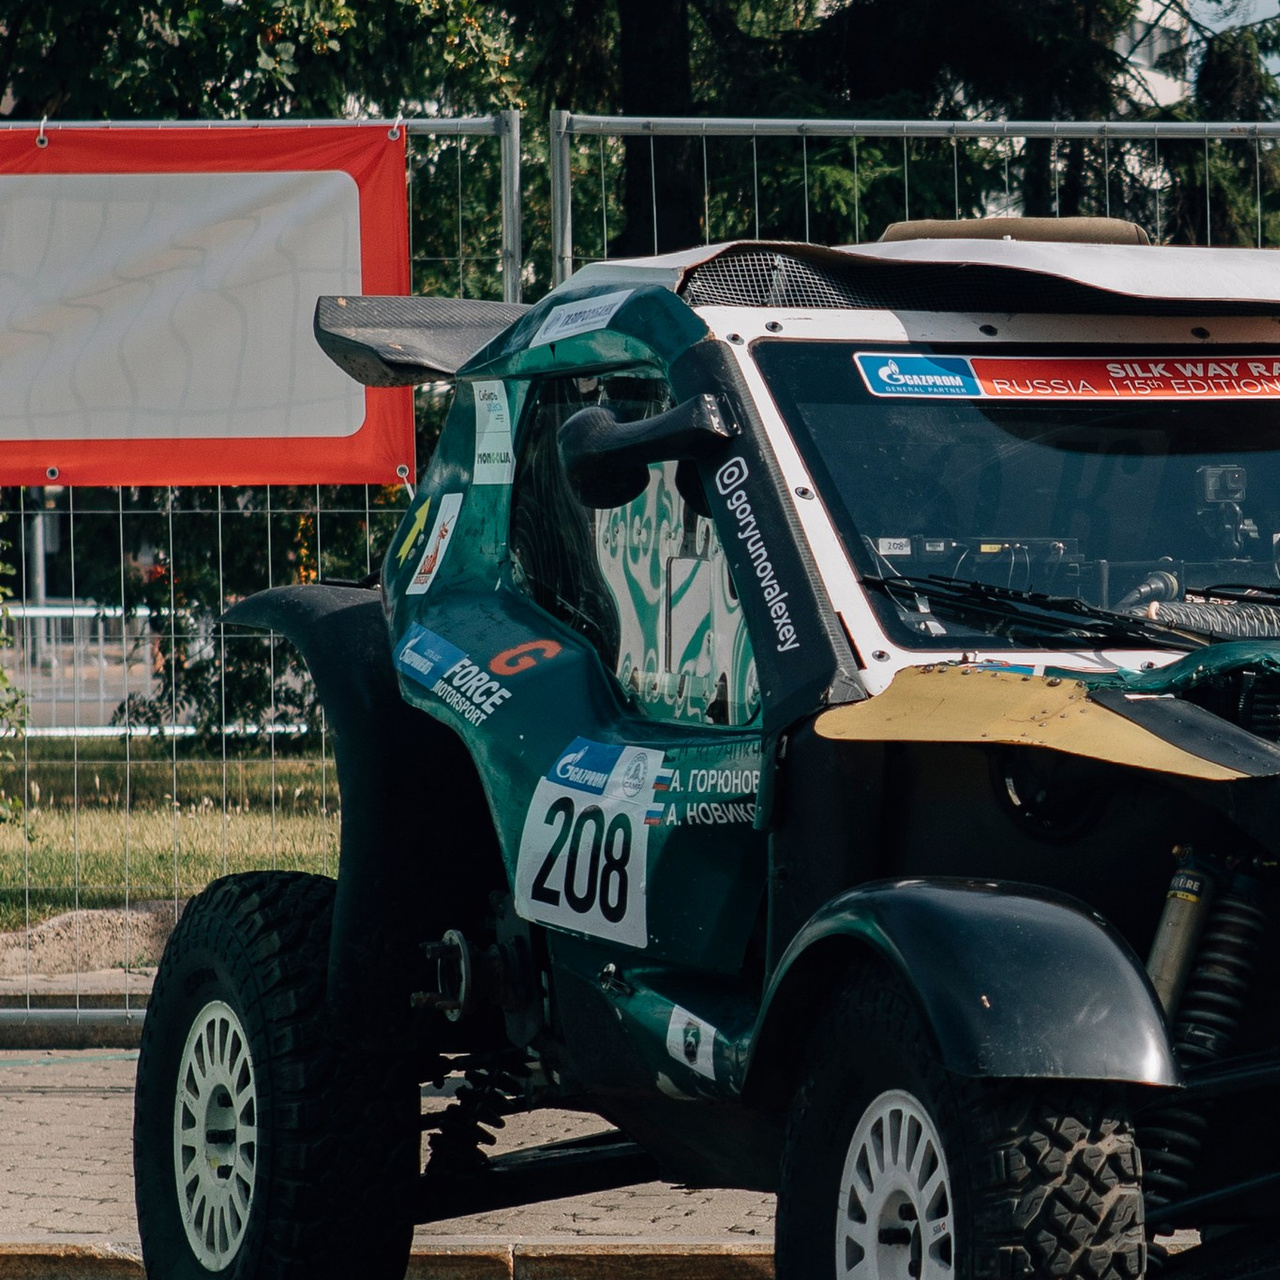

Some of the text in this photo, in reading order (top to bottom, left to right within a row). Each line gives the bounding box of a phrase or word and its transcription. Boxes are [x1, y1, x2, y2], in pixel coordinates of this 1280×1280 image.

[904, 375, 964, 387] GAZPROM
[1106, 362, 1171, 378] SILK
[1174, 362, 1242, 377] WAY
[993, 379, 1099, 395] RUSSIA
[1123, 378, 1163, 395] 15th
[1171, 378, 1280, 394] EDITION
[727, 490, 800, 653] goryunovalexey
[489, 639, 562, 676] G
[443, 657, 513, 715] FORCE
[433, 679, 488, 727] MOTORSPORT
[669, 769, 760, 794] А. ГОРЮНОВ
[666, 802, 682, 826] А.
[531, 796, 633, 924] 208
